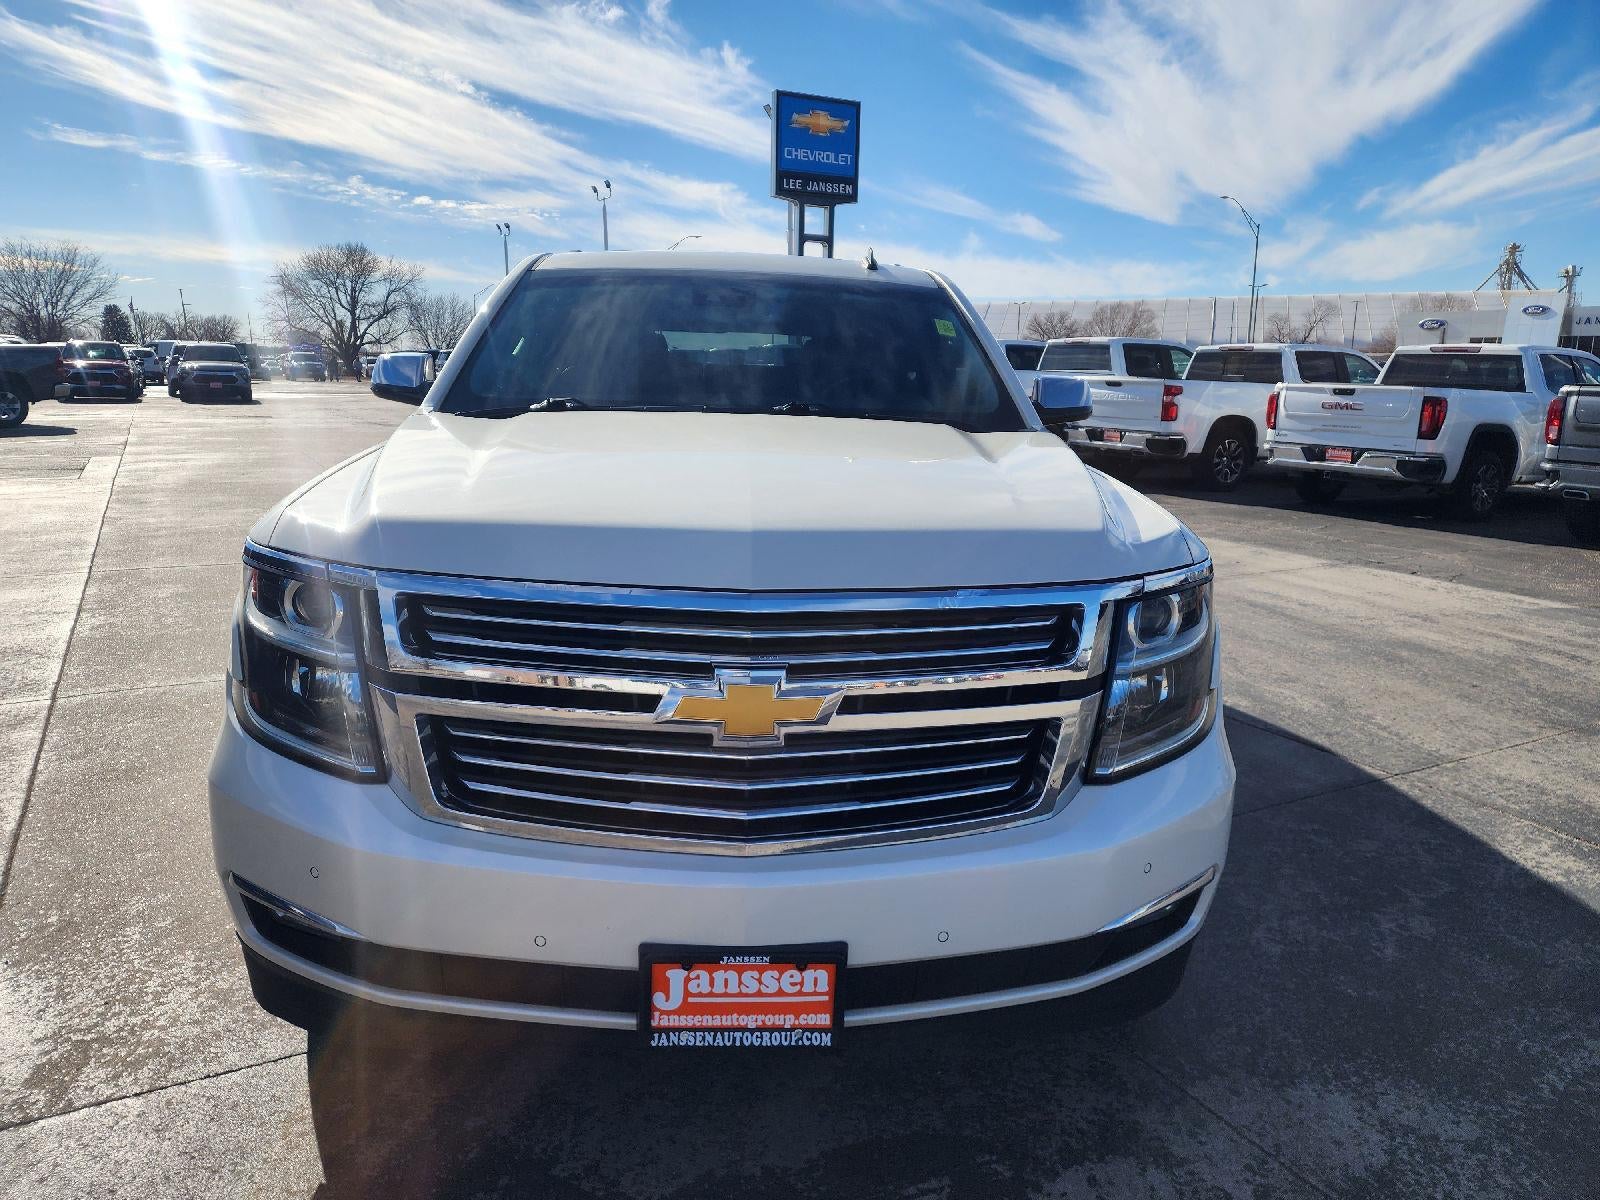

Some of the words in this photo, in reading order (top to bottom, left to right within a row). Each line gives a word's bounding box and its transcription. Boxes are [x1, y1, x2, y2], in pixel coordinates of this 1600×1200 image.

[784, 147, 852, 165] CHEVROLET
[783, 178, 802, 190] LEE
[806, 181, 853, 195] JANSSEN
[1321, 401, 1364, 411] GMC
[720, 956, 770, 964] JANSSEN
[653, 968, 829, 1011] Janssen
[651, 1011, 831, 1028] Janssenautogroup.com
